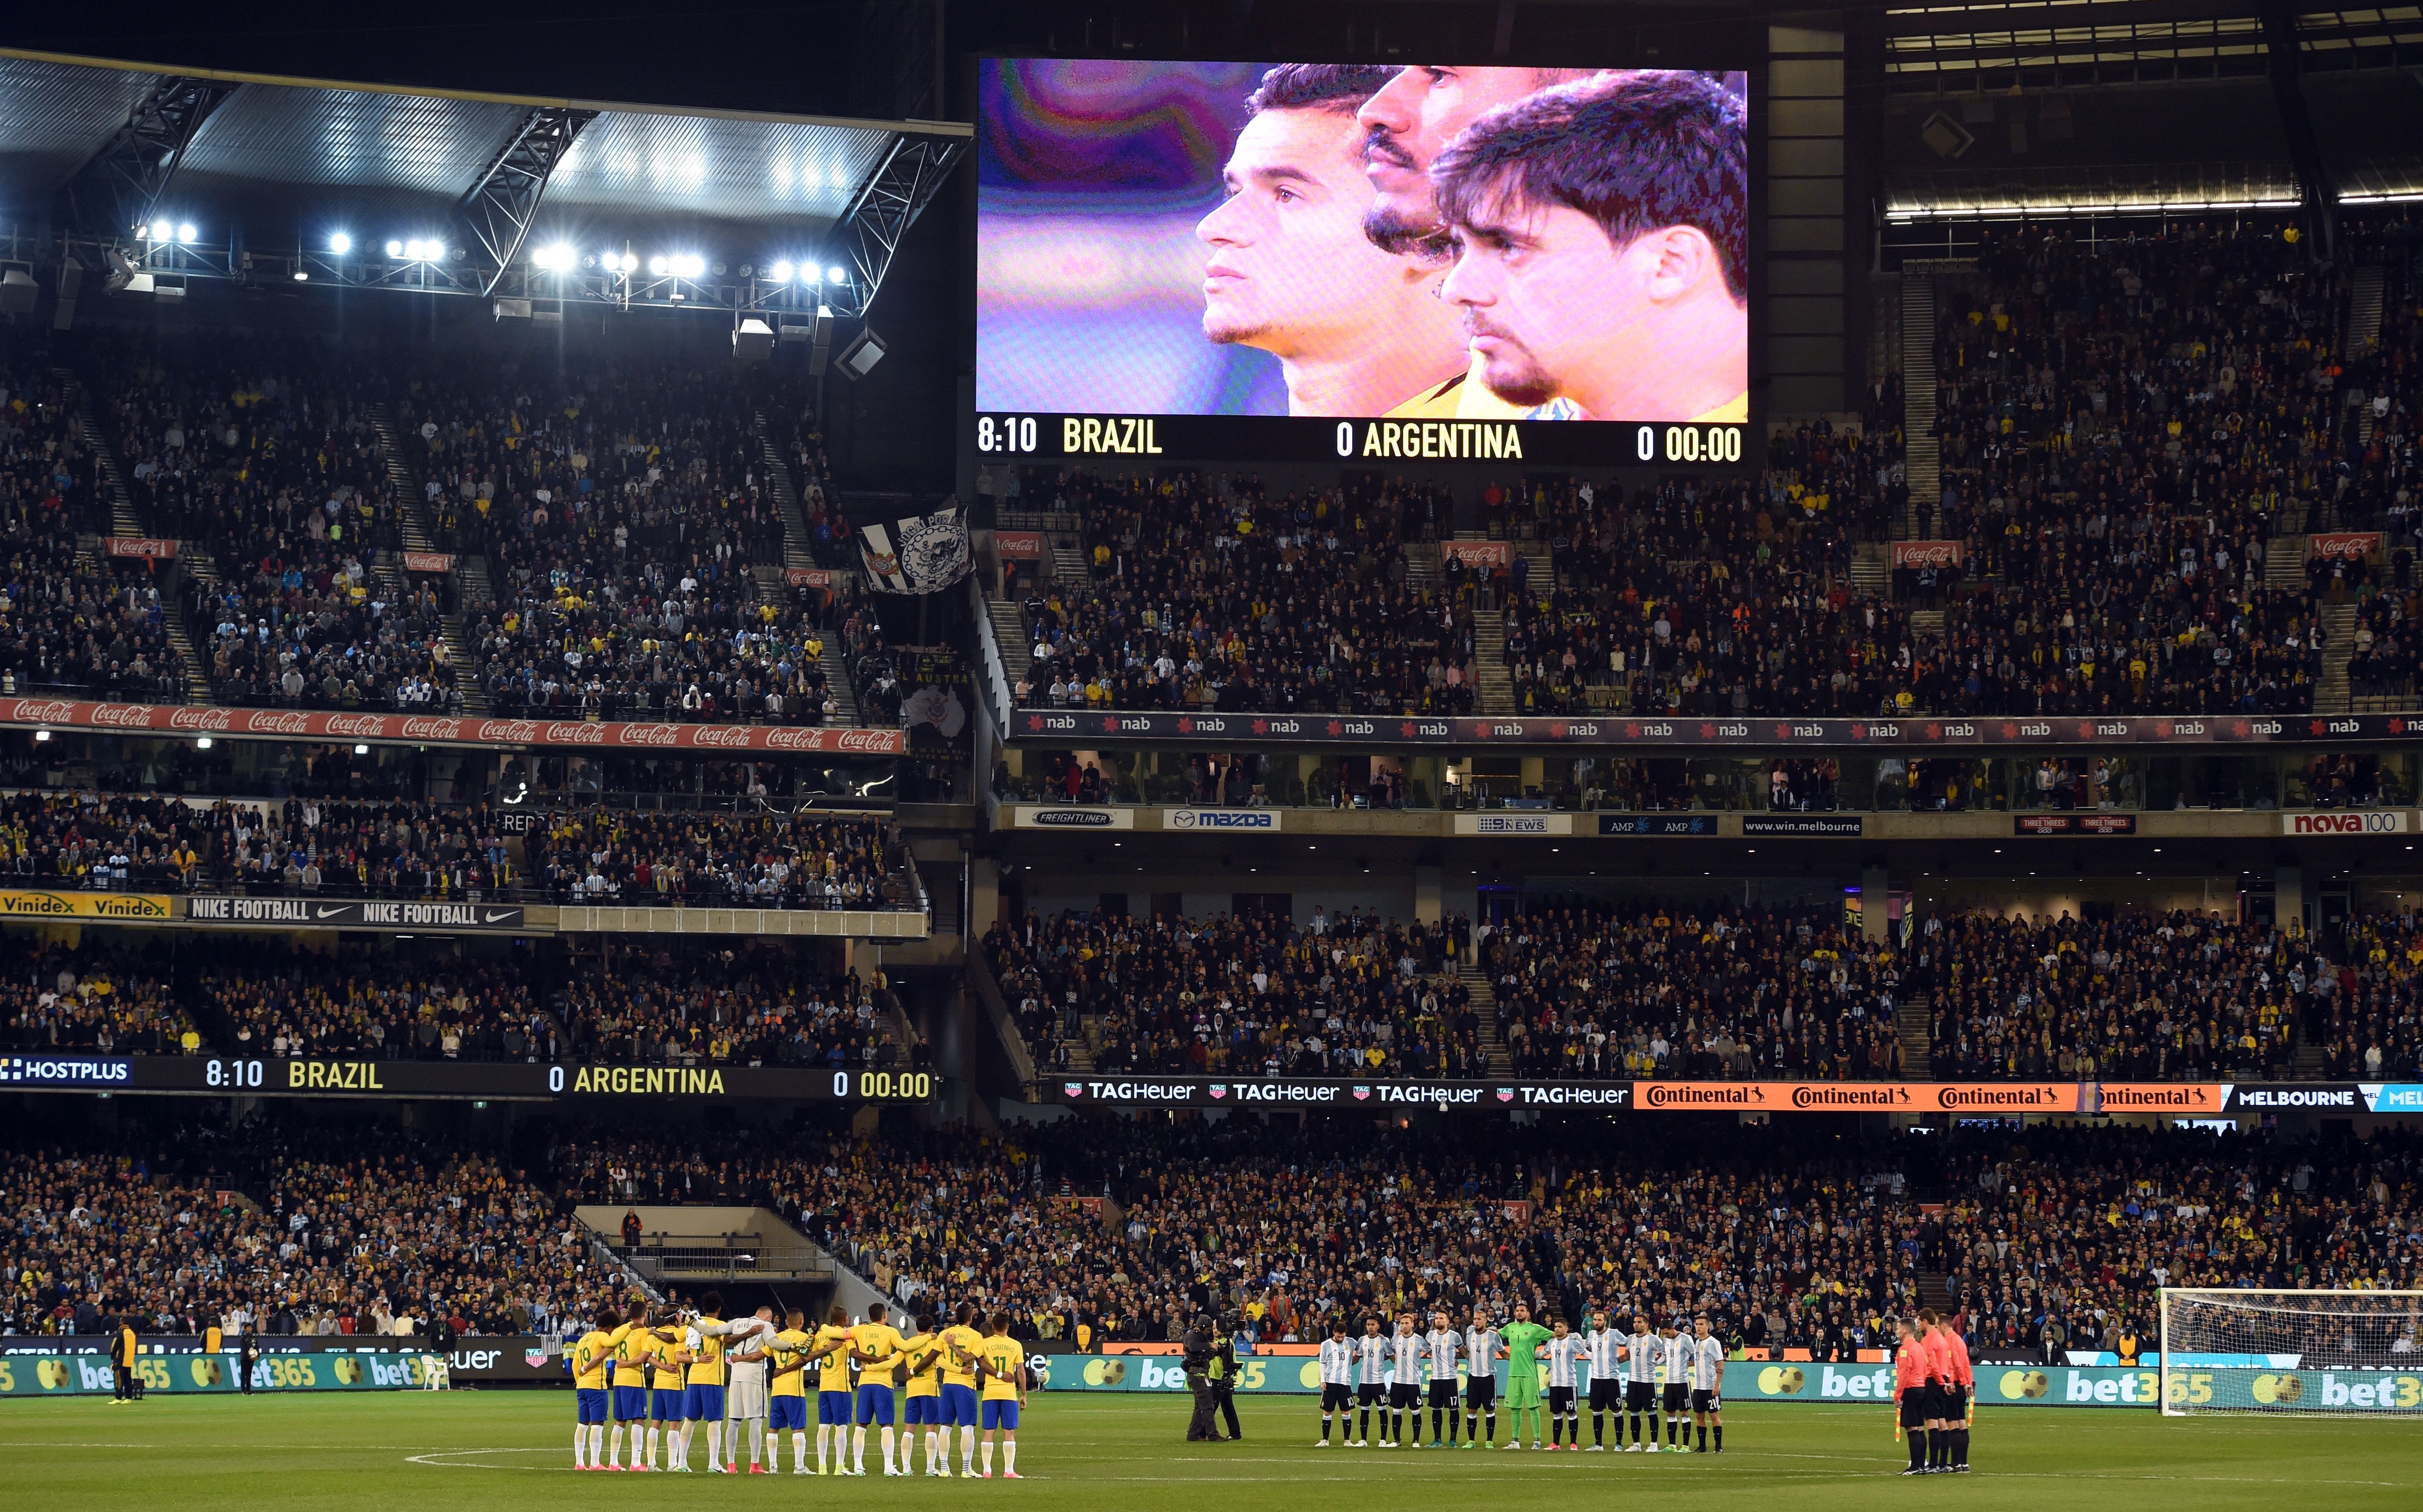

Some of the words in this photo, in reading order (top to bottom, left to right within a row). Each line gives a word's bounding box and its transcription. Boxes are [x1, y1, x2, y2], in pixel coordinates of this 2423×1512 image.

[978, 417, 1036, 452] 8:10
[1064, 418, 1162, 453] BRAZIL
[1337, 422, 1353, 457] 0
[1362, 422, 1523, 459] ARGENTINA
[1638, 426, 1654, 461] 0
[1666, 427, 1741, 462] 00:00
[927, 514, 950, 526] POR
[1001, 539, 1034, 551] Coca-Cola
[1904, 547, 1950, 562] Coca-Cola
[410, 555, 444, 568] Coca-Cola
[13, 699, 76, 723] Coca-Cola
[89, 704, 154, 727] Coca-Cola
[170, 708, 234, 730] Coca-Cola
[248, 711, 311, 733] Coca-Cola
[325, 714, 387, 736] Coca-Cola
[1047, 716, 1075, 729] nab
[1122, 717, 1151, 731] nab
[1196, 718, 1225, 732] nab
[401, 717, 463, 739] Coca-Cola
[478, 720, 539, 741] Coca-Cola
[1271, 720, 1300, 733] nab
[1345, 721, 1374, 734] nab
[1419, 722, 1448, 736] nab
[1494, 723, 1523, 735] nab
[1569, 723, 1597, 736] nab
[1644, 723, 1673, 736] nab
[1719, 723, 1748, 736] nab
[1794, 724, 1823, 737] nab
[1869, 724, 1898, 737] nab
[1945, 723, 1975, 736] nab
[2021, 723, 2050, 736] nab
[2098, 722, 2127, 735] nab
[2174, 721, 2205, 735] nab
[2252, 721, 2282, 734] nab
[2330, 719, 2360, 733] nab
[546, 723, 607, 743] Coca-Cola
[620, 724, 680, 745] Coca-Cola
[693, 726, 754, 747] Coca-Cola
[766, 727, 826, 749] Coca-Cola
[838, 730, 899, 752] Coca-Cola
[1039, 813, 1107, 824] FREIGHTLINER
[1611, 822, 1634, 831] AMP
[1665, 823, 1688, 832] AMP
[1745, 821, 1860, 831] www.win.melbourne
[4, 896, 75, 913] Vinidex
[95, 899, 165, 916] Vinidex
[192, 899, 229, 918] NIKE
[234, 900, 309, 920] FOOTBALL
[363, 903, 399, 922] NIKE
[403, 904, 478, 924] FOOTBALL
[26, 1061, 127, 1080] HOSTPLUS
[207, 1059, 263, 1087] 8:10
[289, 1061, 383, 1089] BRAZIL
[549, 1066, 564, 1092] 0
[574, 1067, 724, 1094] ARGENTINA
[833, 1072, 848, 1097] 0
[860, 1072, 929, 1098] 00:00
[1646, 1085, 1748, 1107] Continental
[1792, 1086, 1894, 1108] Continental
[1938, 1087, 2041, 1109] Continental
[2101, 1086, 2189, 1108] ntinental
[2239, 1091, 2354, 1106] MELBOURNE
[619, 1340, 628, 1361] 8
[991, 1344, 1014, 1353] COUTINHO
[1367, 1348, 1374, 1358] 16
[1435, 1345, 1442, 1354] 17
[1476, 1344, 1480, 1354] 4
[1597, 1342, 1602, 1351] 9
[1636, 1347, 1641, 1357] 2
[1670, 1348, 1674, 1358] 11
[450, 1350, 502, 1369] uer
[579, 1346, 591, 1367] 19
[658, 1346, 667, 1365] 6
[1338, 1352, 1345, 1361] 10
[1555, 1349, 1561, 1358] 19
[369, 1356, 448, 1386] bet3
[993, 1356, 1007, 1378] 11
[78, 1358, 171, 1390] be65
[1140, 1359, 1267, 1389] be5
[2066, 1370, 2213, 1404] bet365
[1347, 1396, 1355, 1407] 10
[1379, 1395, 1387, 1404] 16
[1416, 1396, 1422, 1405] 6
[1450, 1396, 1457, 1406] 17
[1490, 1398, 1495, 1407] 4
[1565, 1400, 1573, 1411] 19
[1616, 1397, 1621, 1407] 9
[1651, 1398, 1657, 1408] 2
[1684, 1399, 1690, 1408] 11
[1708, 1398, 1716, 1410] 21
